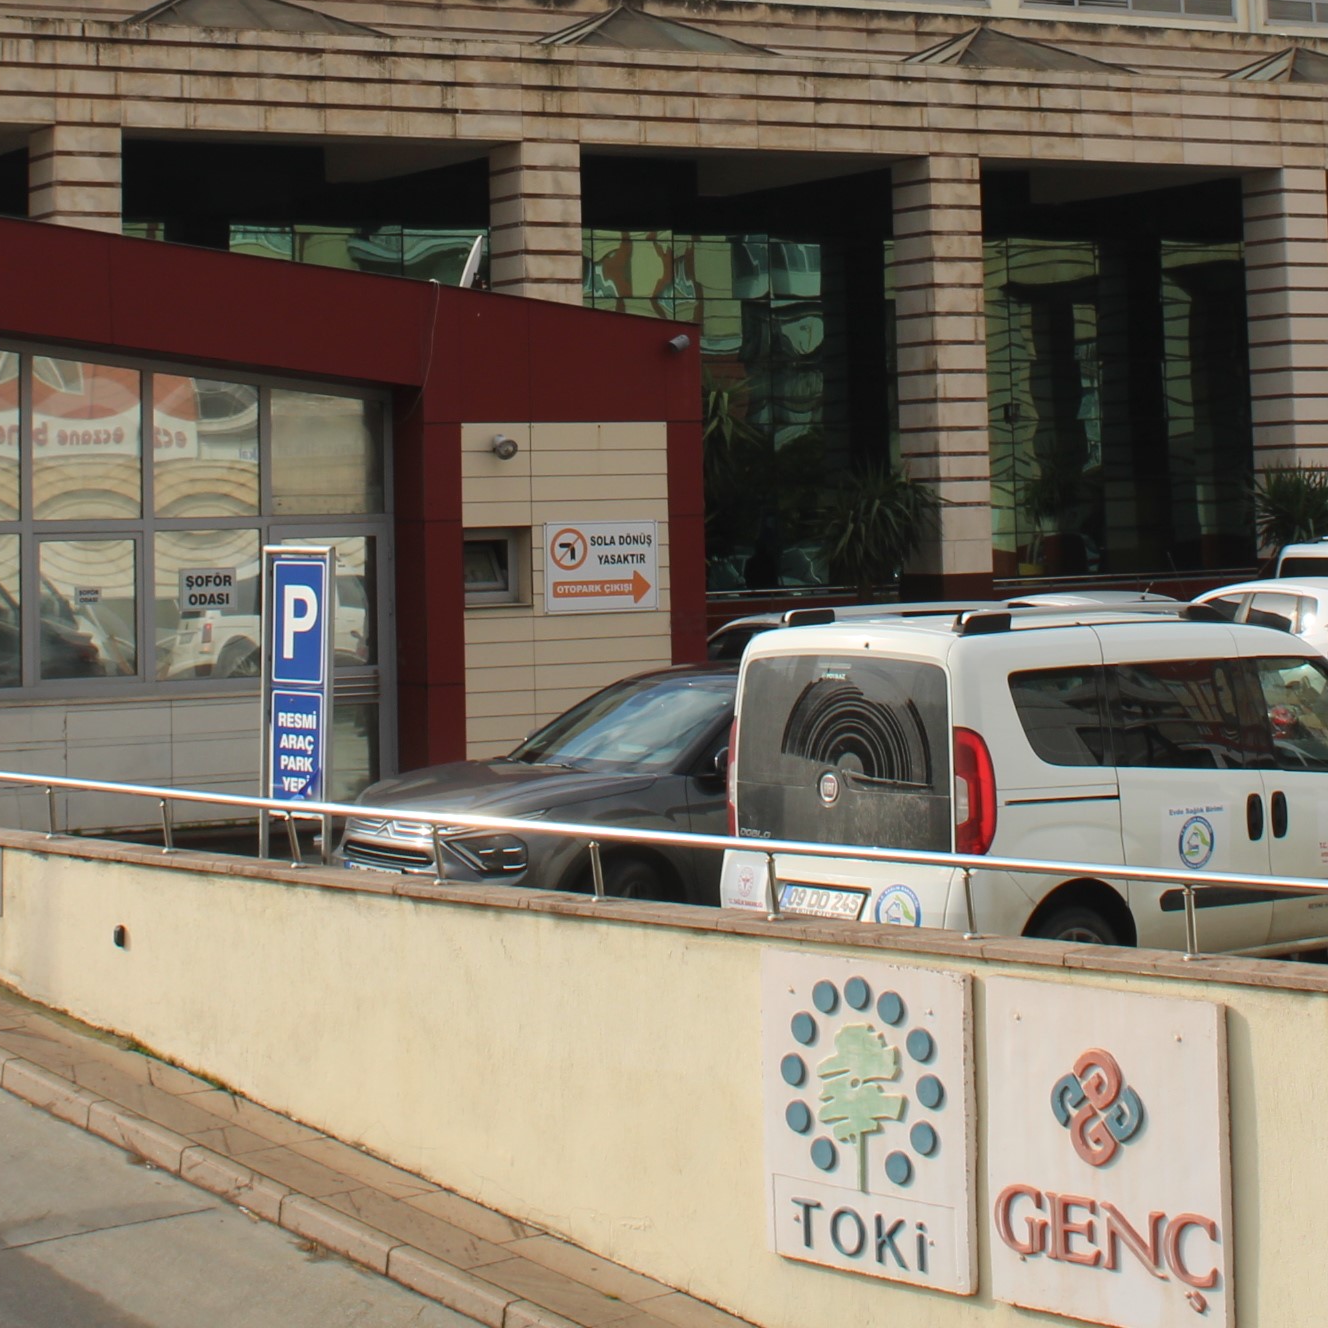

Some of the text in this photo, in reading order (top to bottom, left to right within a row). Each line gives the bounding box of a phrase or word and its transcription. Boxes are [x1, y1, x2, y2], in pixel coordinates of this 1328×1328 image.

[590, 532, 653, 548] SOLA DÖNÜŞ
[597, 553, 646, 565] YASAKTIR
[185, 572, 232, 590] ŞOFÖR
[556, 582, 632, 594] OTOPARK ÇIKIŞI
[188, 592, 230, 606] ODASI
[283, 584, 319, 659] P
[278, 710, 317, 730] RESMİ
[279, 734, 315, 755] ARAÇ
[280, 755, 313, 773] PARK
[740, 827, 771, 839] DOBLO
[787, 888, 804, 906] 09
[806, 890, 830, 909] DD
[834, 892, 862, 913] 245
[790, 1196, 929, 1273] TOKİ
[993, 1183, 1221, 1314] GENÇ
